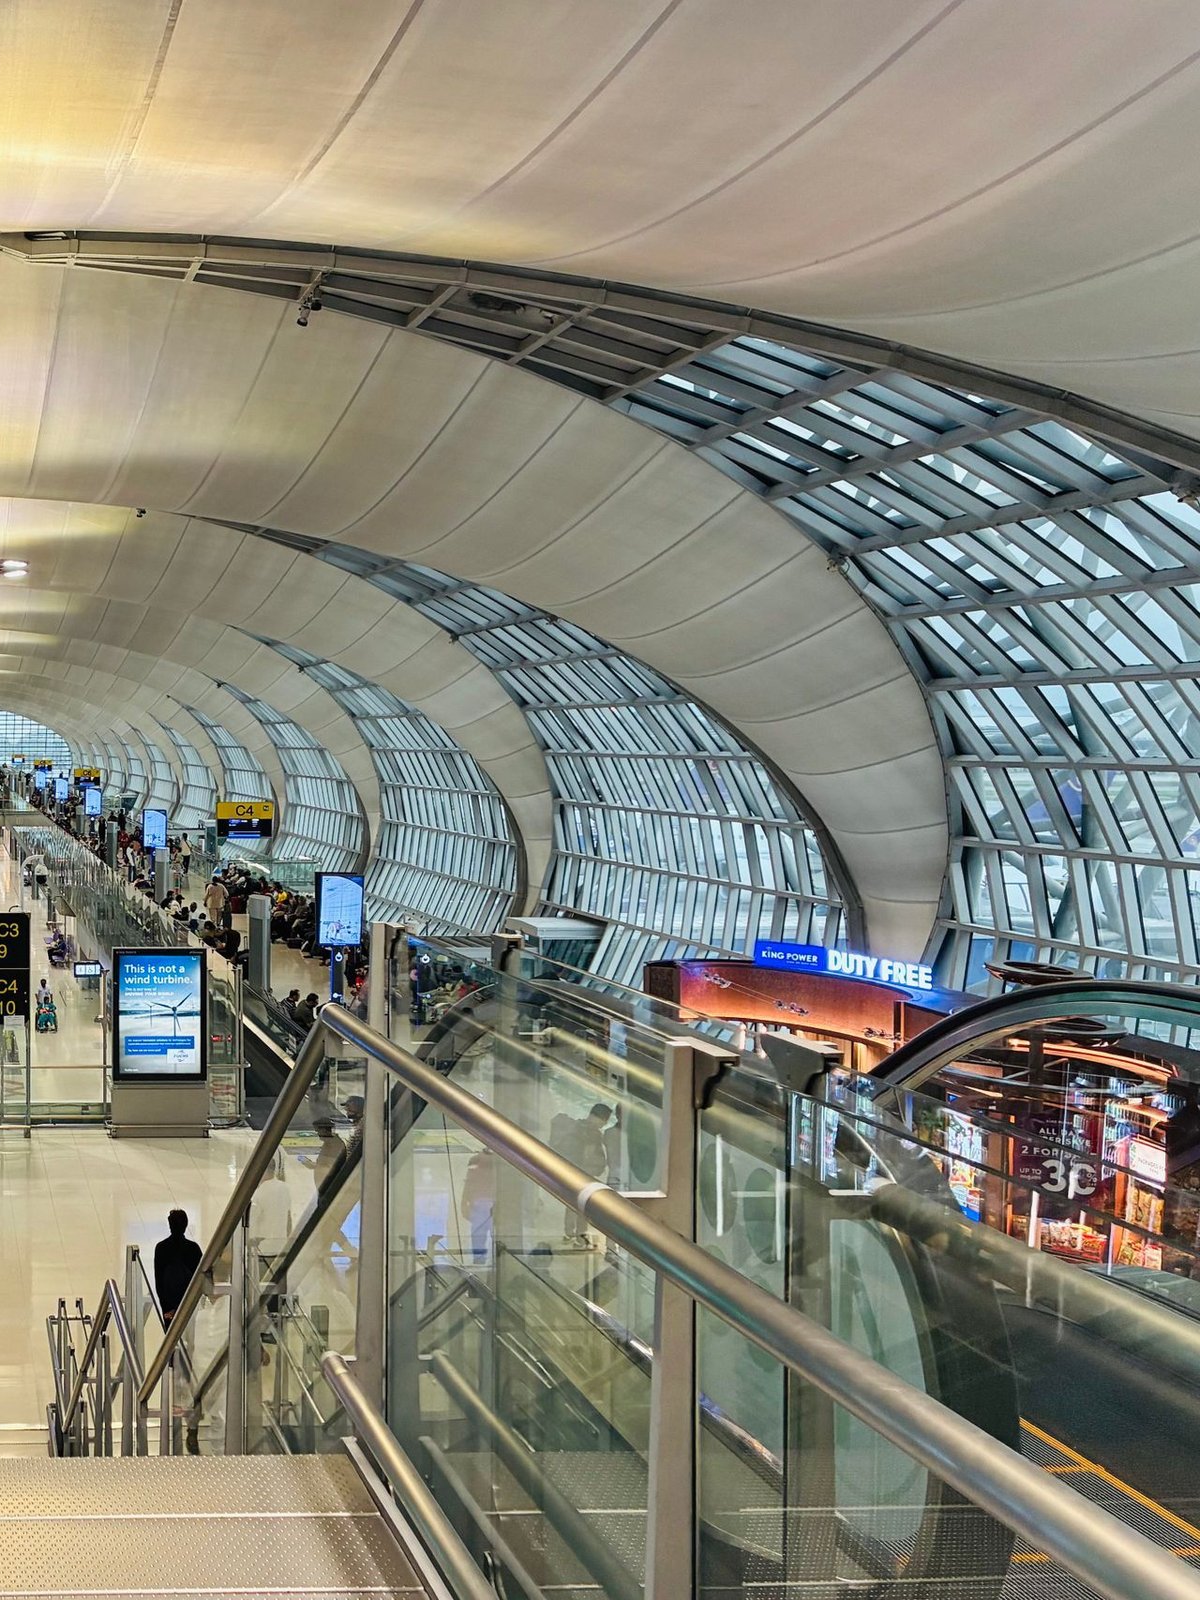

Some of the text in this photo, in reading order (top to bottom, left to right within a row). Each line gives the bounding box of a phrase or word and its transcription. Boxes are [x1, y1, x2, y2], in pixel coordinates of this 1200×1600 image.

[235, 805, 254, 816] C4
[762, 950, 818, 963] KING POWER
[124, 964, 145, 973] This
[148, 964, 155, 973] is
[159, 965, 176, 973] not
[828, 949, 932, 990] DUTY FREE
[124, 975, 193, 984] wind turbine.
[1038, 1127, 1056, 1135] ALL
[1021, 1145, 1029, 1154] 2
[1033, 1147, 1059, 1157] FOR
